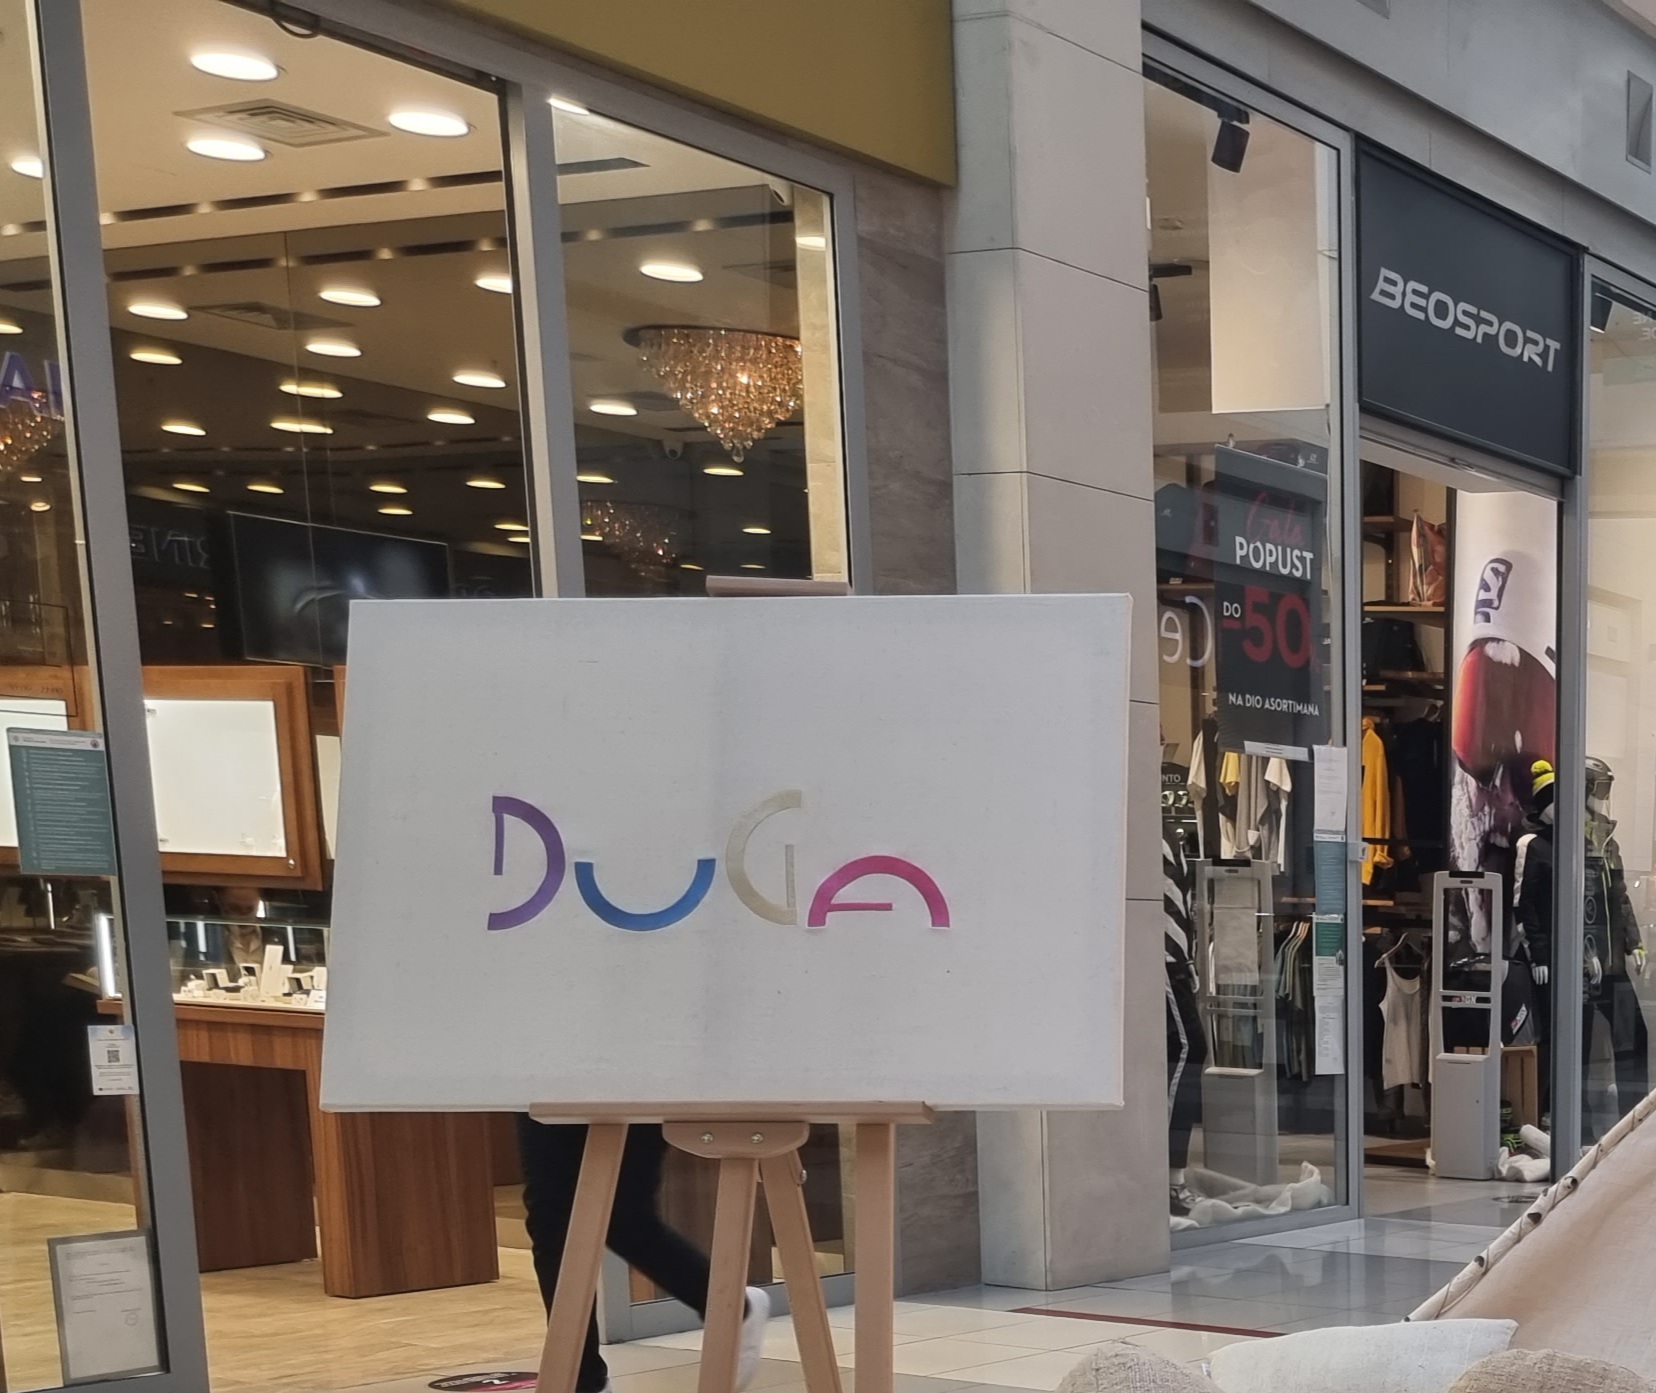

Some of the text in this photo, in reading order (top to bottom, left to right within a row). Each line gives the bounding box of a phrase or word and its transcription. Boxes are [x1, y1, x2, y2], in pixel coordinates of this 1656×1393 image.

[1369, 266, 1561, 373] BEOSPORT
[1235, 535, 1314, 580] POPUST
[1223, 601, 1241, 618] DO
[1229, 692, 1319, 716] NA DIO ASORTIMANA
[487, 789, 951, 932] DUGA
